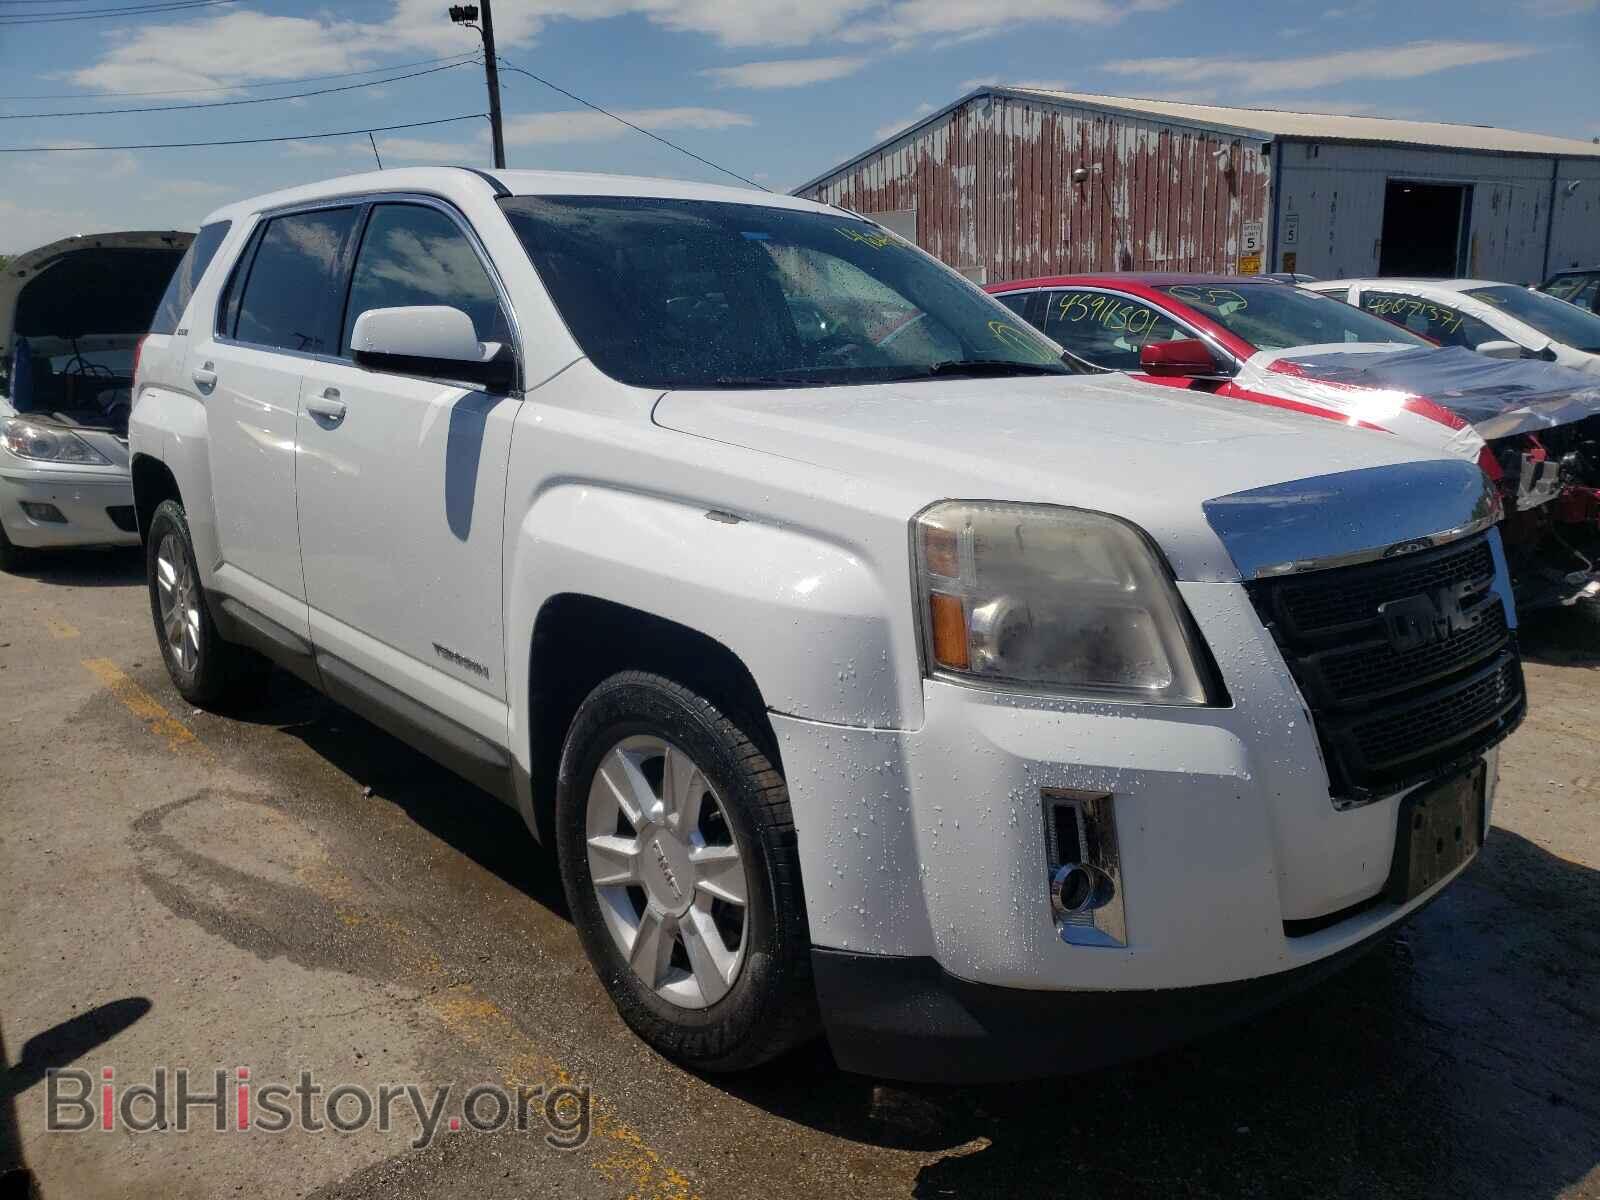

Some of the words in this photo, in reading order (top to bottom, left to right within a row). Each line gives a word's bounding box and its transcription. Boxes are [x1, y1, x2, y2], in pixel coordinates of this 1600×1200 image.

[1287, 230, 1295, 241] 5
[1247, 237, 1256, 249] 5
[1059, 293, 1160, 344] 45911501
